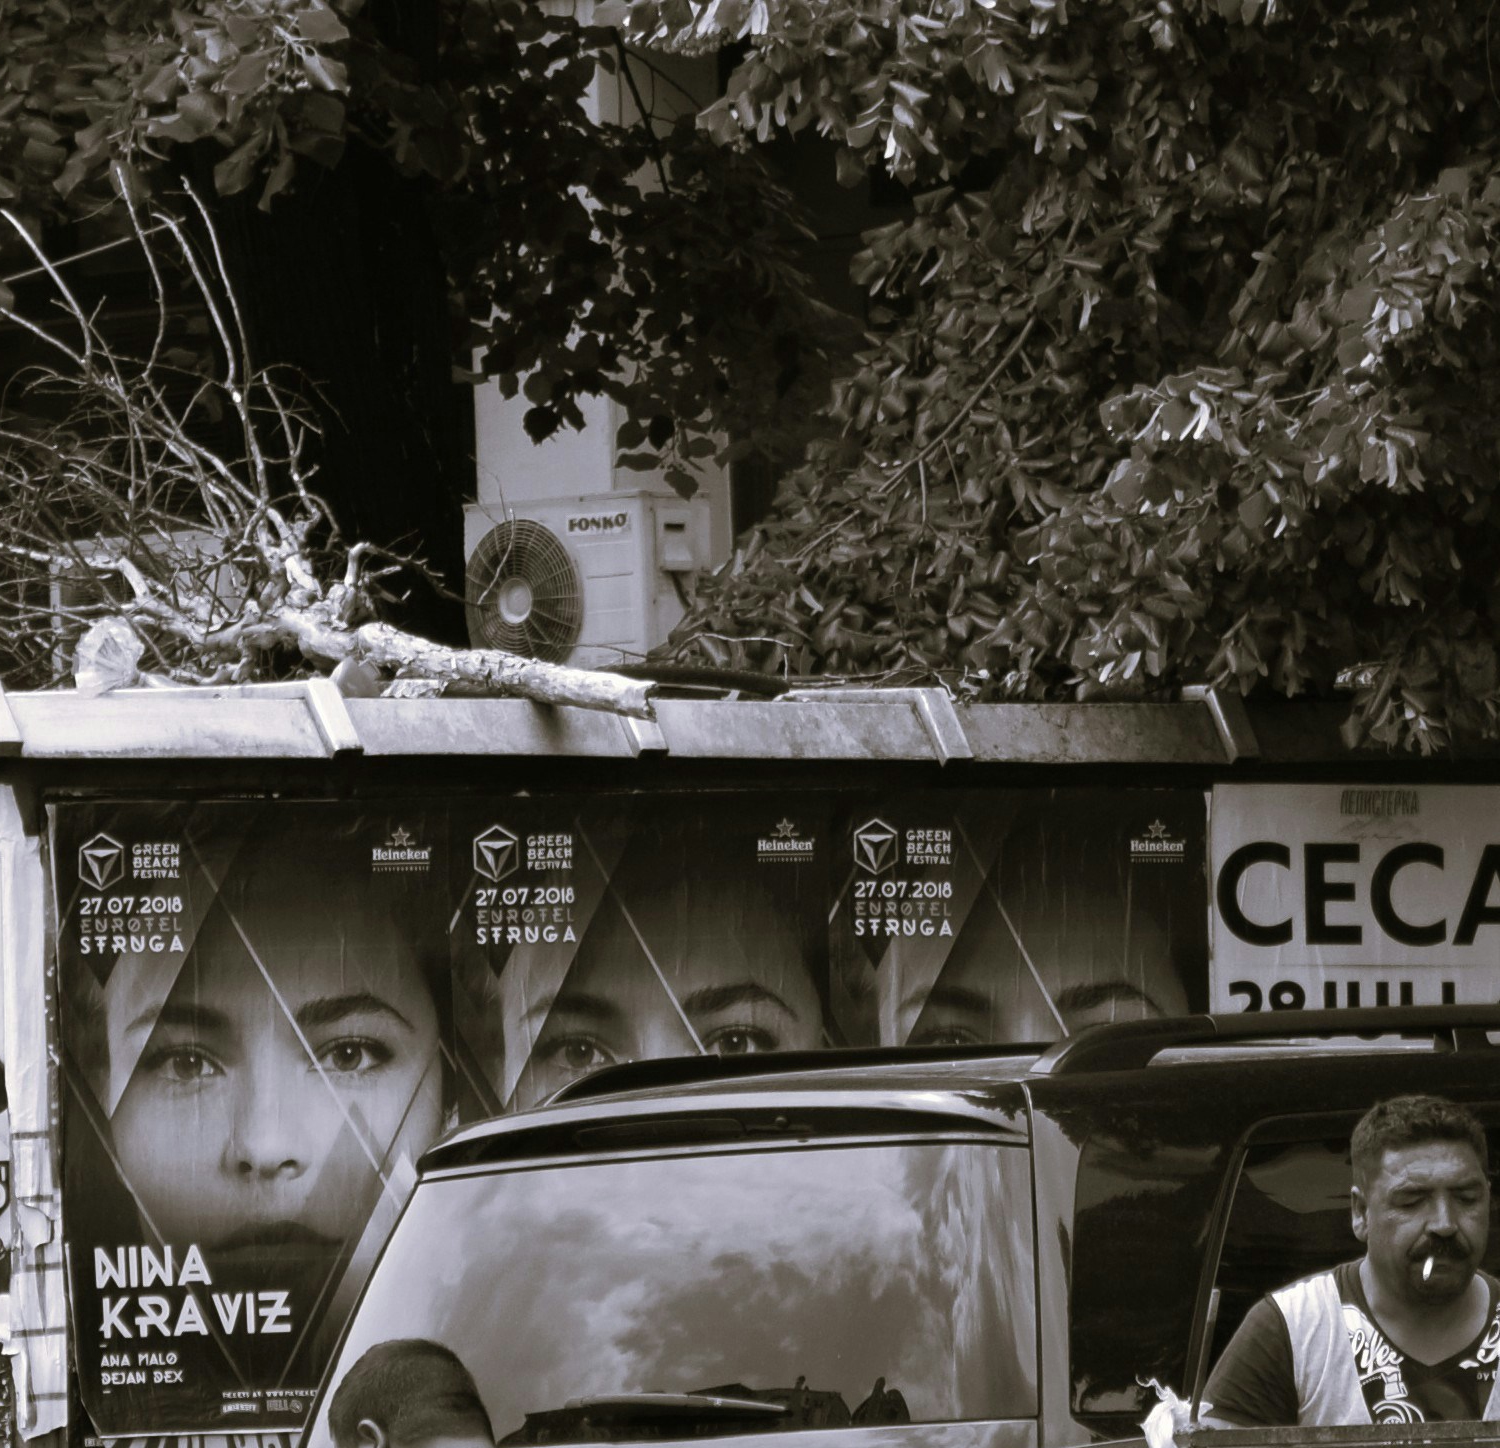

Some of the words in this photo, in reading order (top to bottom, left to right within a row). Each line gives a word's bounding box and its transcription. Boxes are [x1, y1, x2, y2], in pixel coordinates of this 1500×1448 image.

[526, 834, 573, 847] GREEN
[906, 829, 951, 841] GREEN
[132, 843, 180, 855] GREEN
[757, 838, 814, 851] Heineken
[906, 842, 951, 854] BEACH
[1130, 839, 1184, 851] Heineken
[372, 847, 431, 862] Heineken
[526, 848, 573, 859] BEACH
[906, 855, 951, 865] FESTIVAL
[133, 857, 180, 868] BEACH
[527, 860, 573, 870] FESTIVAL
[133, 869, 180, 879] FESTIVAL
[854, 881, 953, 898] 27.07.2018
[475, 887, 575, 906] 27.07.2018
[80, 896, 183, 915] 27.07.2018
[854, 919, 953, 937] STRUGA
[476, 925, 576, 945] STRUGA
[80, 935, 184, 955] STRUGA
[94, 1244, 212, 1289] NINA
[99, 1290, 292, 1339] KRAVIZ
[100, 1354, 131, 1368] ANA
[101, 1371, 146, 1385] DEJAN
[153, 1370, 184, 1384] DEX
